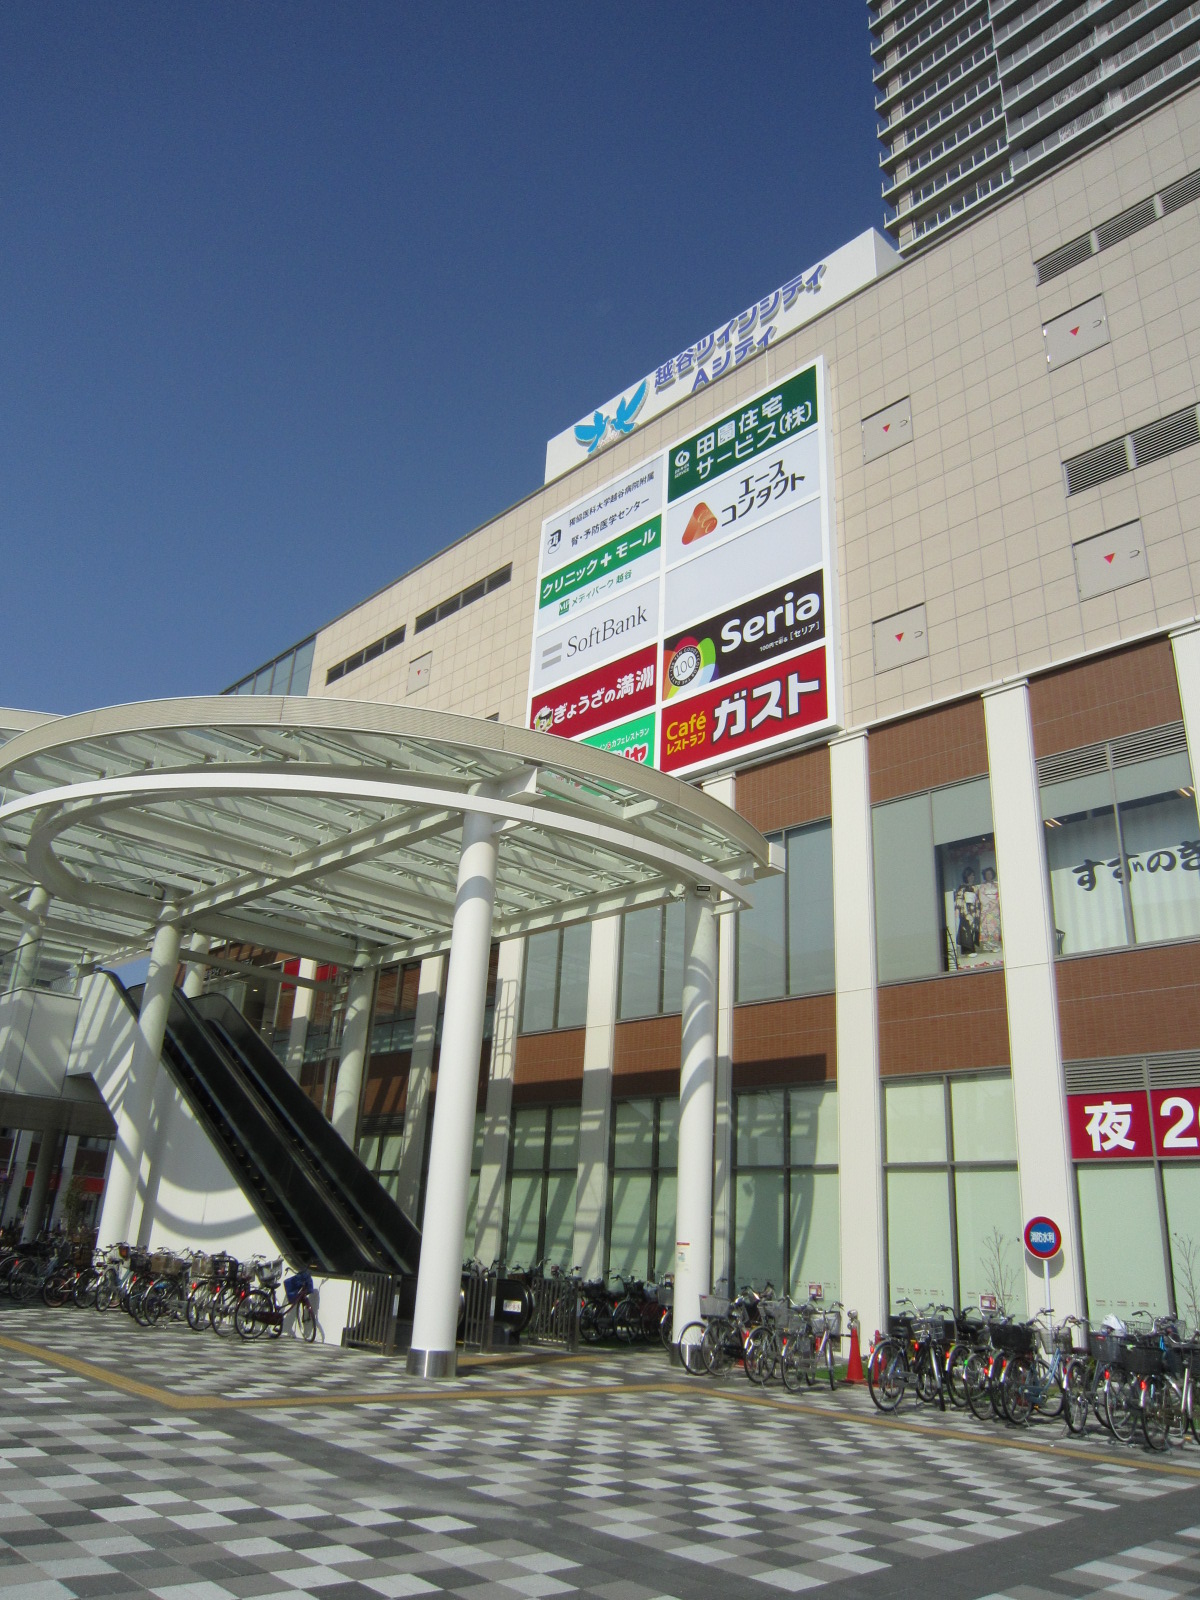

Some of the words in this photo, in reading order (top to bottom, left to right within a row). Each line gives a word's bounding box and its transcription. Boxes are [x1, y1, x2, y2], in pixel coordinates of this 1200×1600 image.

[655, 264, 826, 393] 越谷ツインシティ
[691, 326, 776, 393] Aシティ
[696, 394, 783, 459] 田園住宅
[696, 401, 812, 480] サービス(株)
[721, 472, 806, 528] コンタクト
[738, 459, 786, 499] エース
[542, 558, 598, 600] クリニック
[615, 528, 657, 558] モール
[566, 605, 648, 658] SoftBank
[720, 591, 821, 654] Seria
[554, 664, 655, 724] ぎょうざの満洲
[674, 655, 696, 678] 100
[666, 710, 707, 742] Café
[712, 671, 821, 743] ガスト
[666, 731, 706, 756] レストラン
[1084, 1100, 1136, 1152] 夜
[1159, 1096, 1200, 1149] 2
